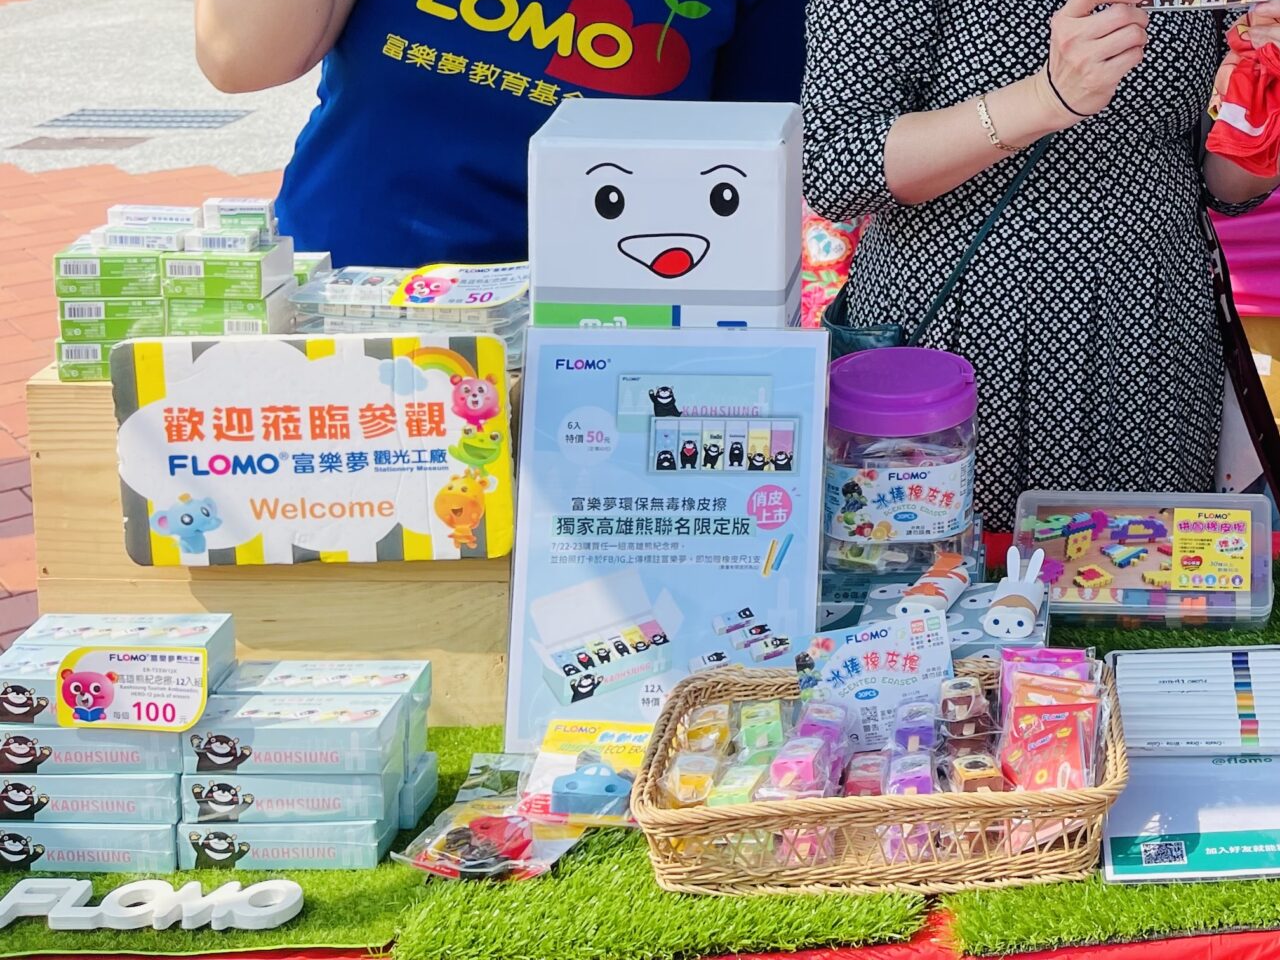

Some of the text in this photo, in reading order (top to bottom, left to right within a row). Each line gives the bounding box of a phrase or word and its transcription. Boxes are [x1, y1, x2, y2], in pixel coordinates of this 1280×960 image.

[465, 292, 494, 303] 50
[555, 358, 607, 371] FLOMO
[682, 406, 760, 417] KAOHSIUNG
[162, 401, 448, 444] 歡迎蒞臨參觀
[567, 421, 581, 430] 6入
[167, 448, 448, 477] FLOMO 富樂夢 觀光工廠
[373, 463, 449, 473] Stationery Museum
[888, 471, 928, 481] FLOMO
[571, 496, 728, 512] 富樂夢環保無毒橡皮擦
[751, 490, 784, 507] 俏皮
[249, 496, 395, 521] Welcome
[756, 507, 789, 524] 上市
[556, 516, 751, 536] 獨家高雄熊聯名限定版
[845, 628, 889, 645] FLOMO
[109, 654, 147, 662] FLOMO
[826, 651, 921, 688] 冰棒橡皮擦
[645, 684, 663, 693] 12入
[641, 697, 661, 707] 特價
[132, 701, 176, 723] 100
[554, 724, 598, 734] FLOMO
[602, 744, 626, 754] ECO
[52, 749, 141, 765] KAOHSIUNG
[252, 750, 340, 765] KAOHSIUNG
[50, 798, 136, 814] KAOHSIUNG
[255, 796, 342, 812] KAOHSIUNG
[46, 849, 132, 864] KAOHSIUNG
[250, 845, 337, 860] KAOHSIUNG
[0, 878, 304, 930] FLOMO
